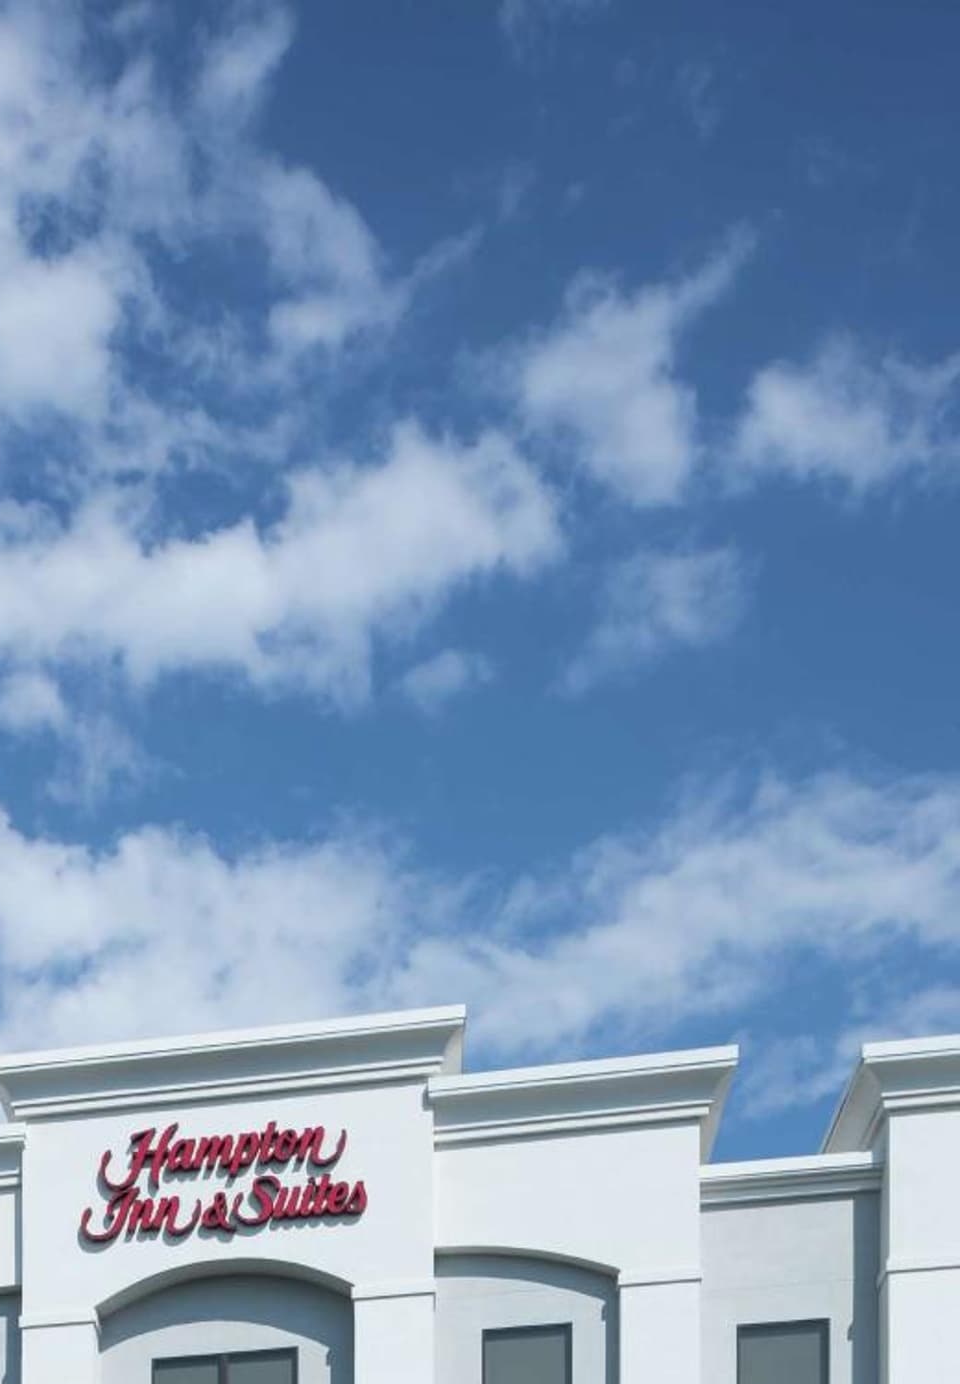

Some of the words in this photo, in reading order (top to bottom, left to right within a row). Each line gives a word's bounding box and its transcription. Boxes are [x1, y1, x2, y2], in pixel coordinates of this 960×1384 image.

[100, 1121, 347, 1191] Hampton
[81, 1187, 202, 1241] Inn
[202, 1191, 236, 1232] &
[234, 1174, 368, 1225] Suites
